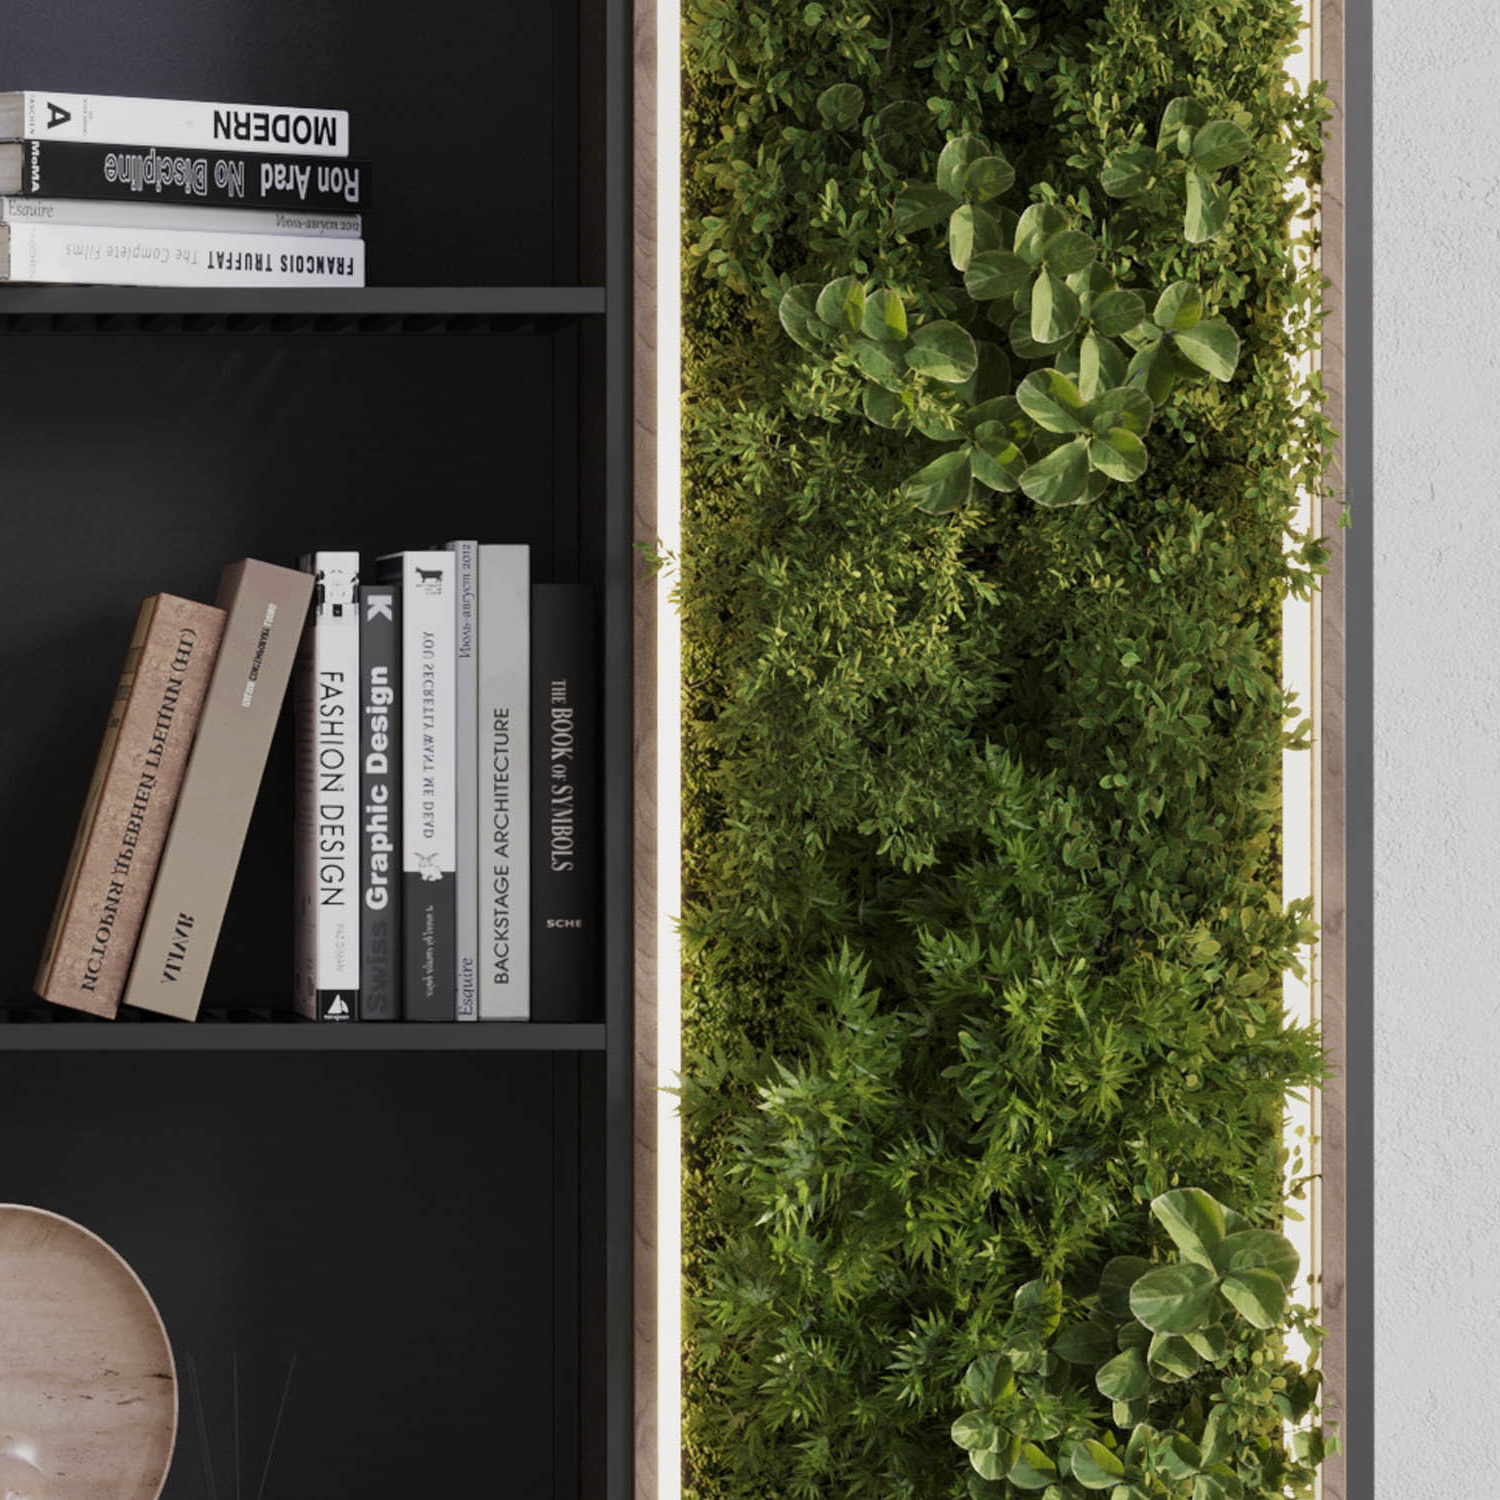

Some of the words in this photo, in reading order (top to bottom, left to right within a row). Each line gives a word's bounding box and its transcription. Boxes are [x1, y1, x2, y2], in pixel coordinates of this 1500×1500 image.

[47, 101, 71, 129] A
[213, 110, 337, 146] MODERN
[31, 141, 40, 192] MoMA
[104, 148, 208, 195] Discipline
[214, 159, 245, 198] No
[261, 163, 311, 200] Arad
[317, 166, 360, 202] Ron
[8, 199, 54, 218] Esquire
[66, 242, 101, 261] Films
[106, 243, 169, 263] Complete
[176, 248, 199, 265] The
[207, 251, 272, 272] TRUFFAT
[280, 254, 355, 276] FRANCOIS
[367, 594, 392, 622] K
[552, 680, 566, 704] THE
[319, 671, 344, 794] FASHION
[366, 665, 395, 775] Design
[552, 707, 573, 761] BOOK
[493, 707, 509, 860] ARCHITECTURE
[552, 784, 573, 872] SYMBOLS
[320, 805, 345, 906] DESIGN
[365, 784, 395, 911] Graphic
[493, 864, 509, 984] BACKSTAGE
[546, 918, 582, 929] SCHE
[365, 920, 388, 1014] Swiss
[457, 957, 477, 1017] Esquire
